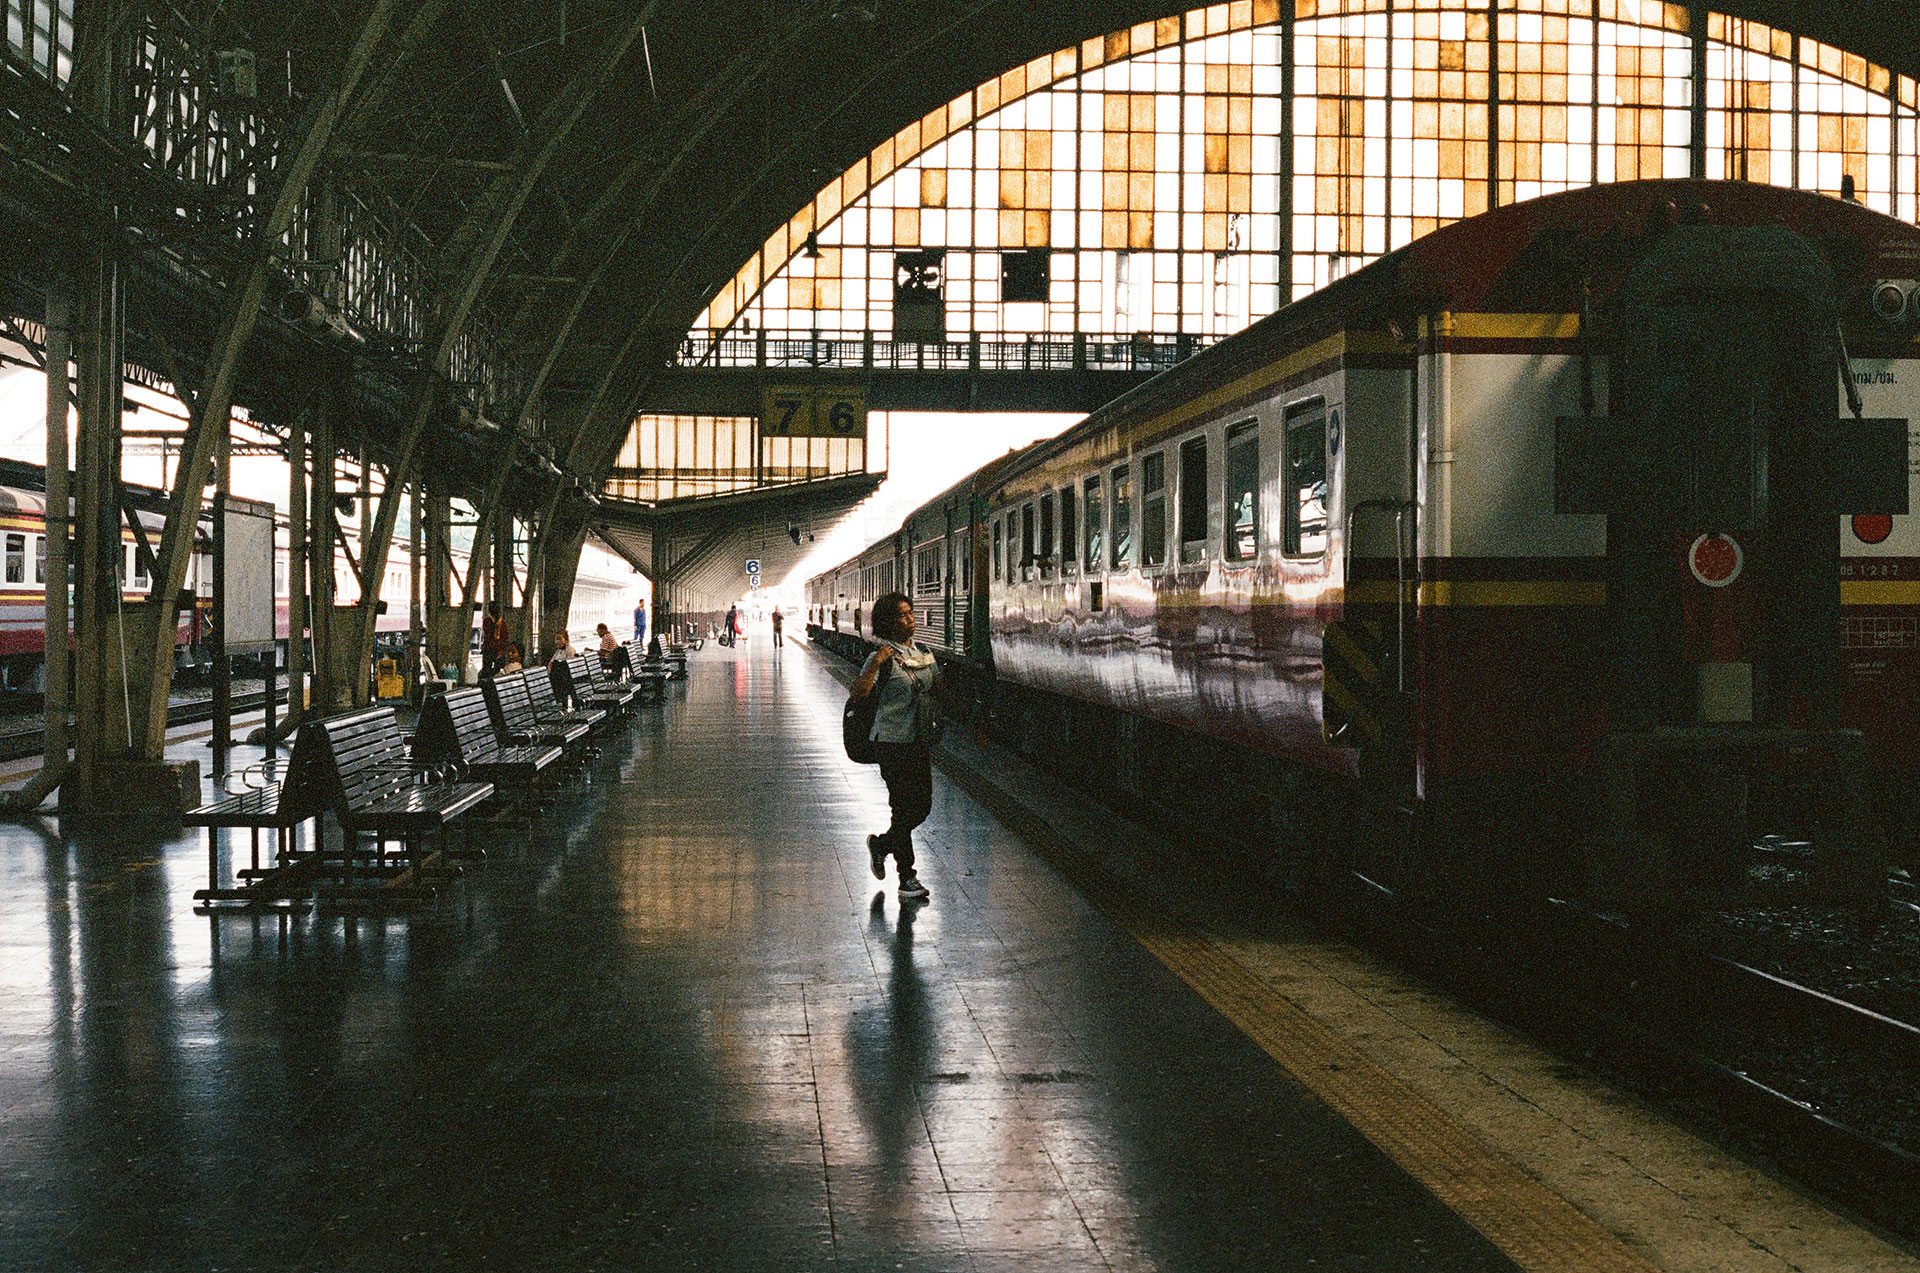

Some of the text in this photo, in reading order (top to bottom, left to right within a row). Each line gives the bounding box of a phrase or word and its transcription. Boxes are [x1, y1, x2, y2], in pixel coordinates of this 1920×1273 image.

[773, 400, 803, 434] 7
[829, 402, 855, 433] 6
[747, 561, 759, 573] 6
[751, 576, 759, 585] 6
